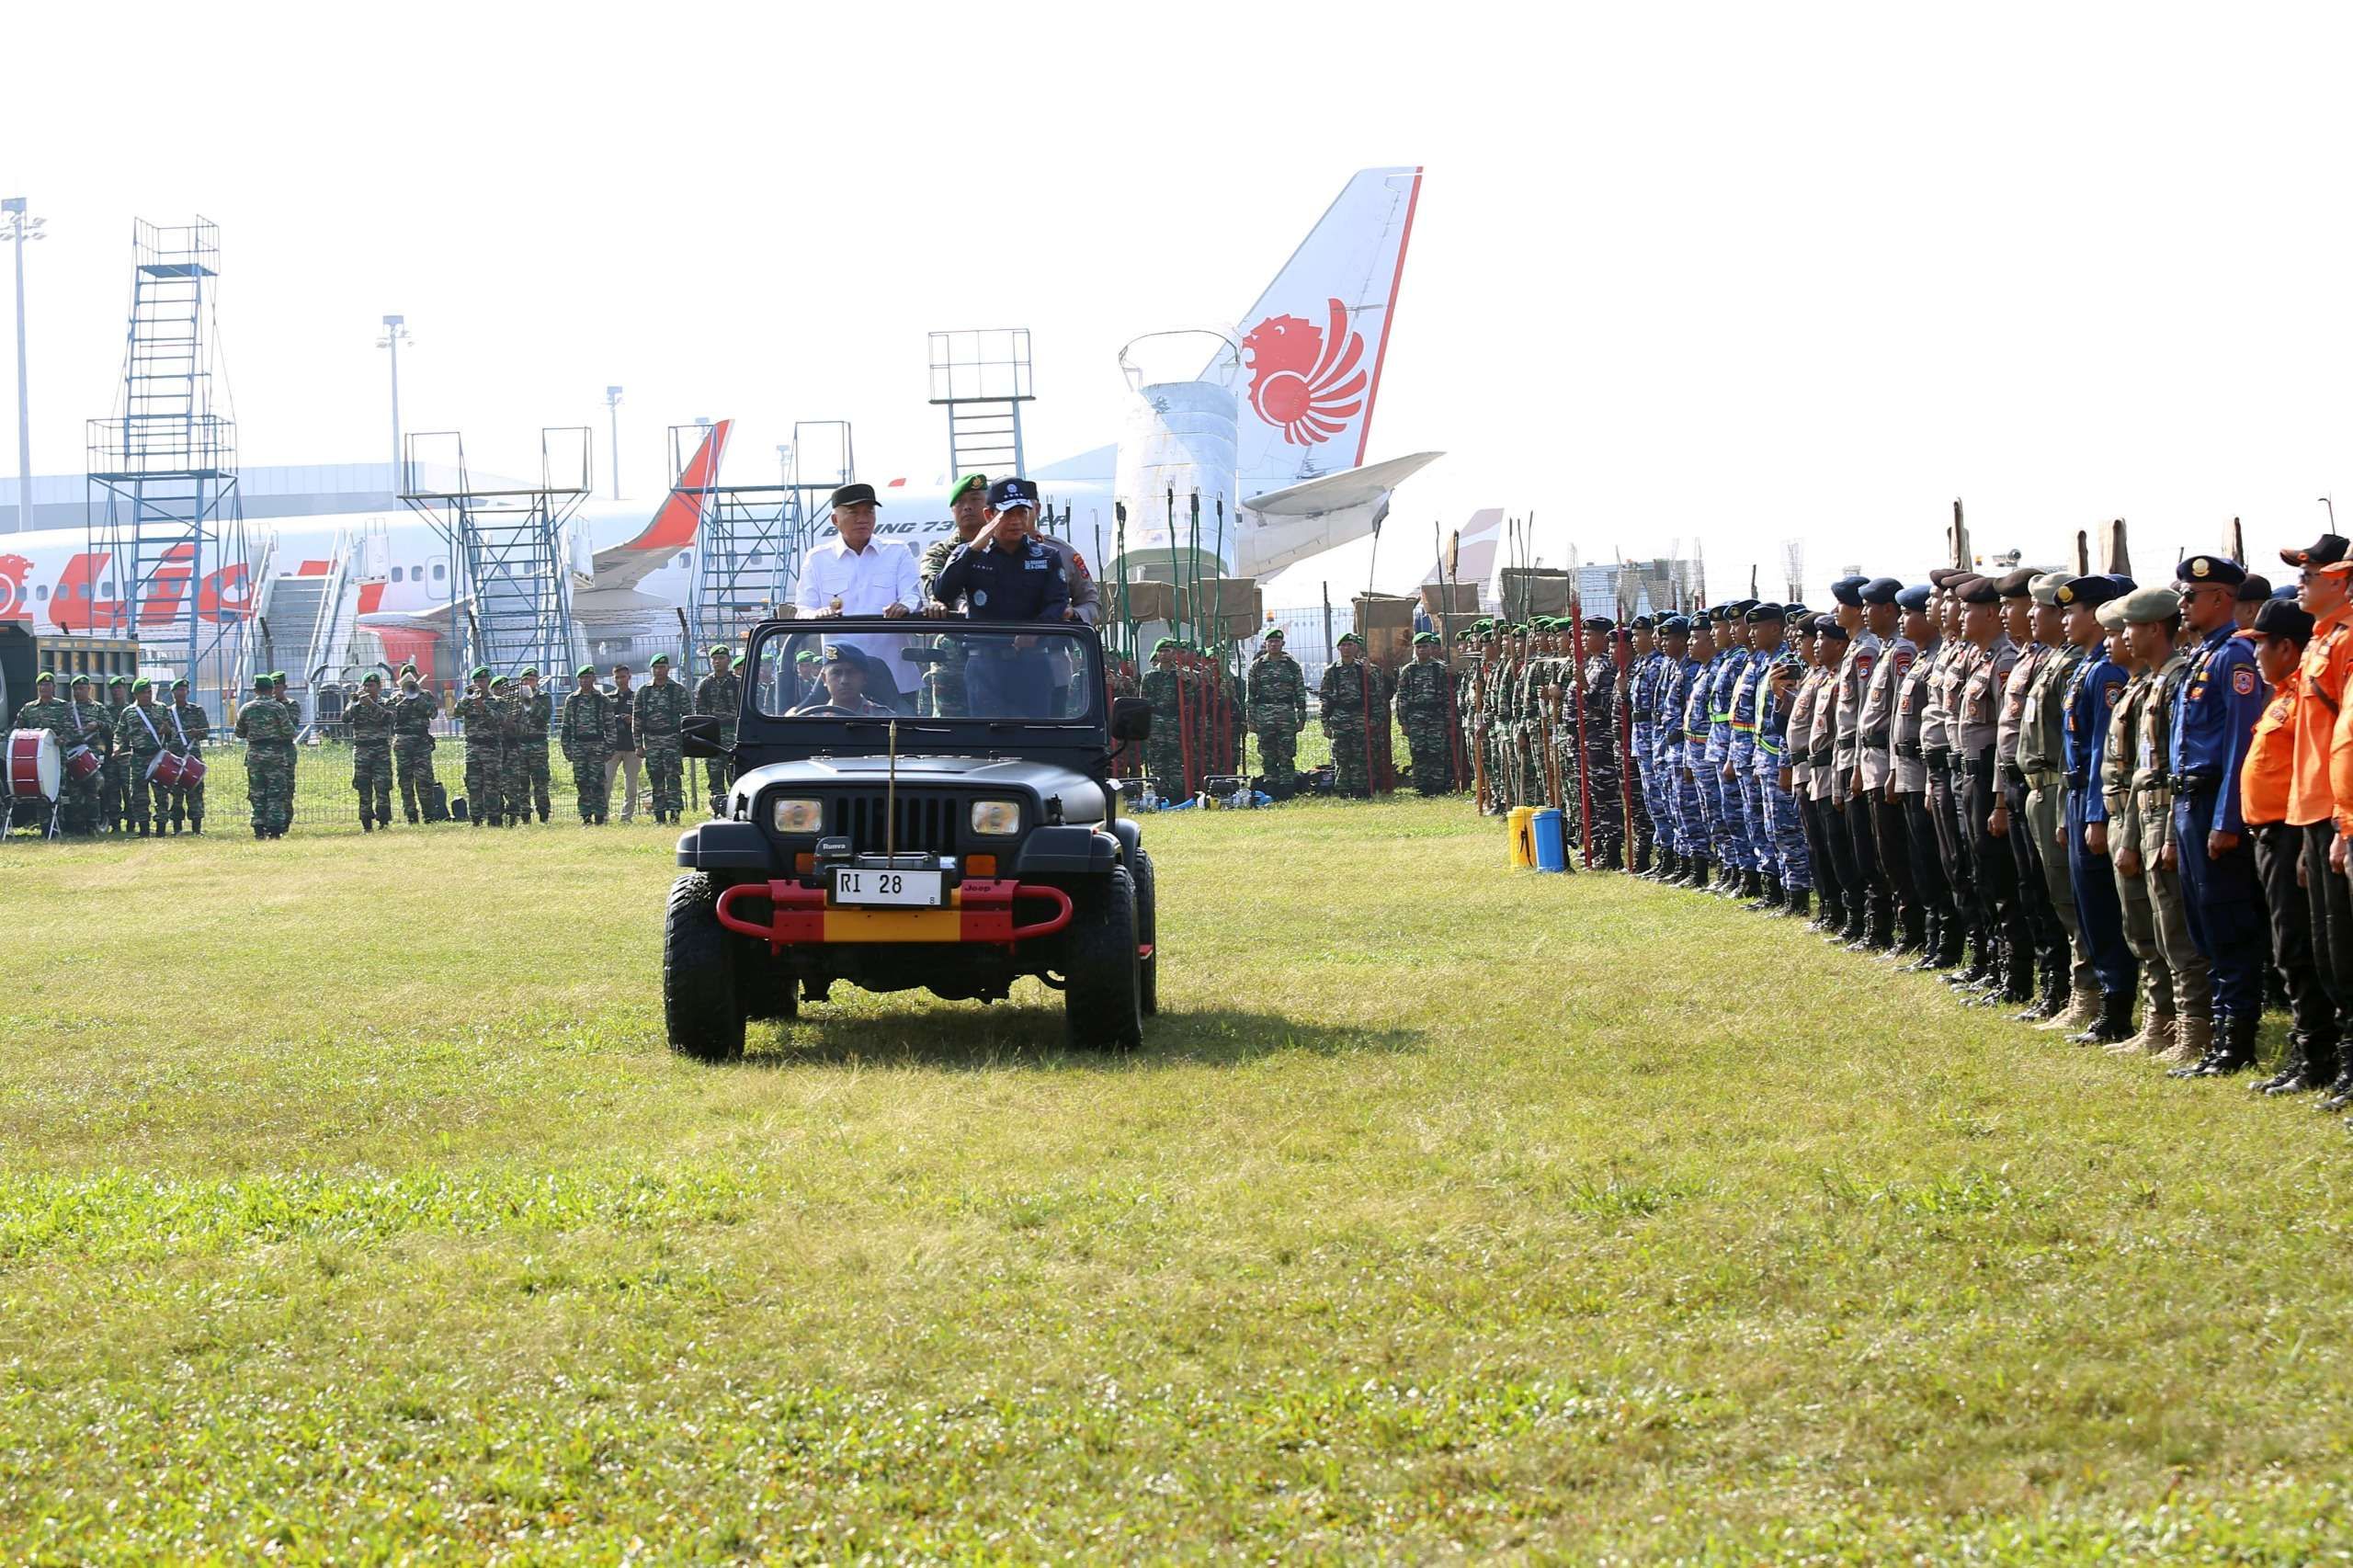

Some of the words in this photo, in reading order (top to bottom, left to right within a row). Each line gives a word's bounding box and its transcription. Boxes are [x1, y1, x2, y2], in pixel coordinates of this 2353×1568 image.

[822, 521, 916, 537] BING
[840, 873, 861, 892] RI
[879, 874, 902, 893] 28
